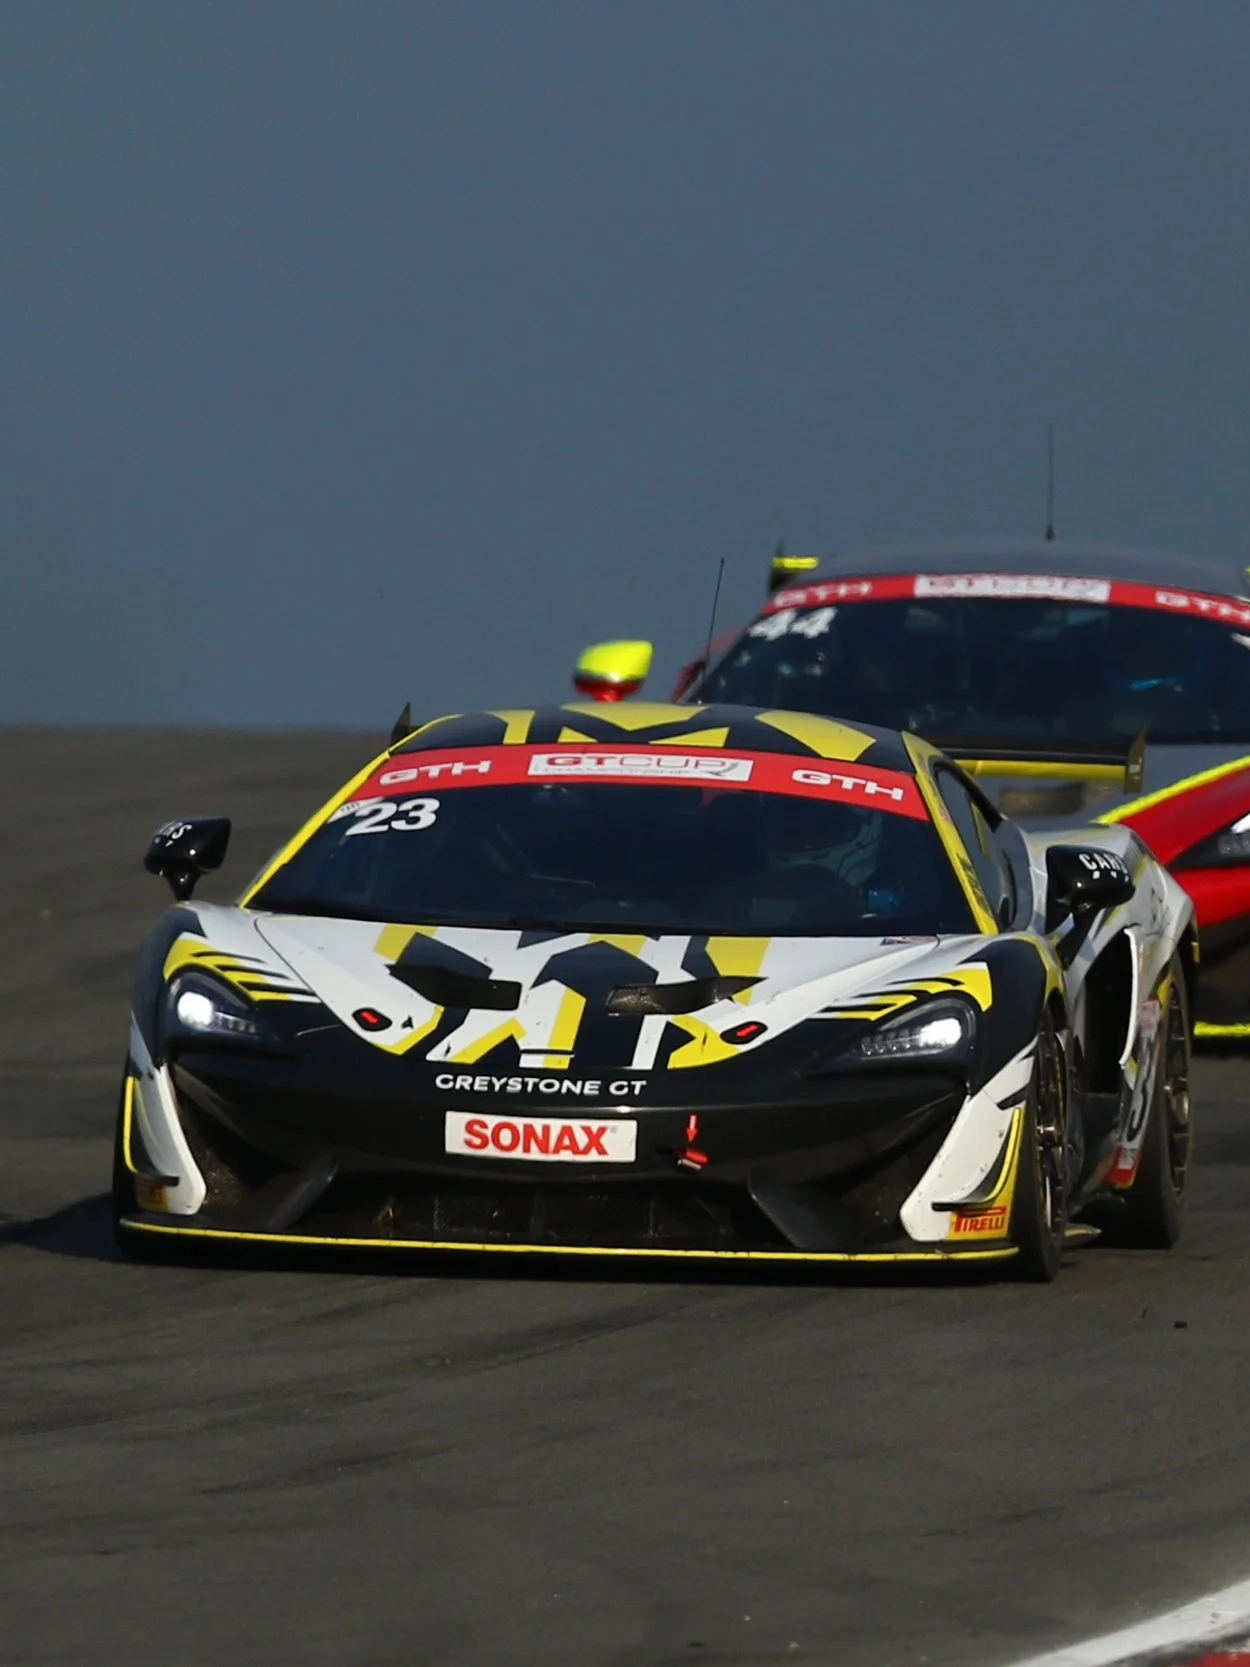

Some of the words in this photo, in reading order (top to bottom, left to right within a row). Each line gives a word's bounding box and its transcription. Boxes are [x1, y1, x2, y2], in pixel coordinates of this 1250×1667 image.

[750, 607, 838, 641] 44
[379, 759, 492, 786] GTH
[791, 769, 904, 800] GTH
[345, 798, 440, 836] 23
[435, 1074, 602, 1096] GREYSTONE
[608, 1080, 647, 1096] GT
[463, 1118, 609, 1156] SONAX
[954, 1206, 1007, 1232] PIRELLI
